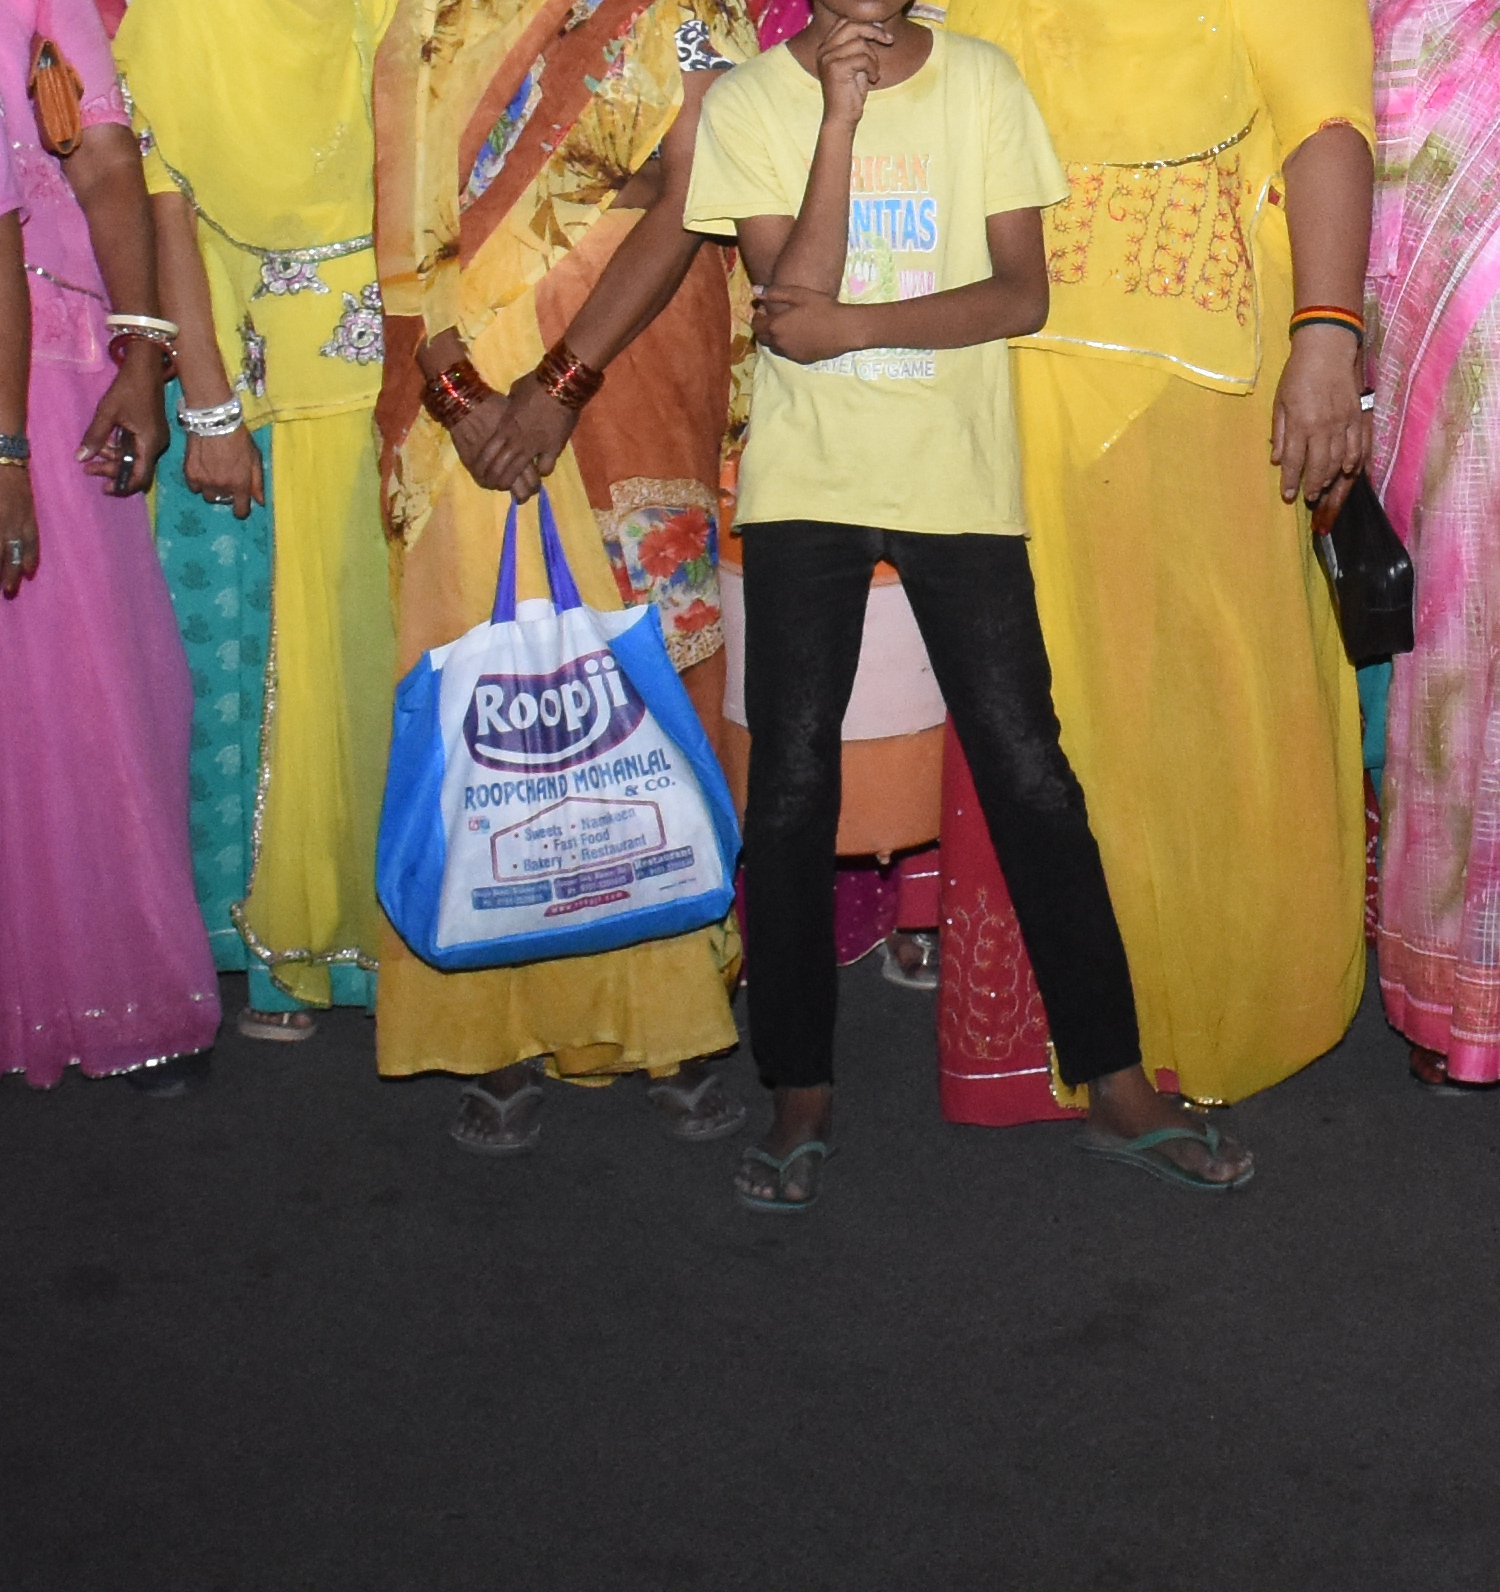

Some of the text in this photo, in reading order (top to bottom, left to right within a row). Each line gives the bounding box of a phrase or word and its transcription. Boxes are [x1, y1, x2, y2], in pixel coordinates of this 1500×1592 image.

[886, 360, 936, 379] GAME
[474, 655, 629, 764] Roopji
[464, 748, 672, 810] ROOPCHAND MOHANLAL
[624, 775, 676, 797] & CO.
[524, 824, 563, 842] Sweets
[553, 828, 611, 852] Fast Food
[581, 833, 647, 861] Restaurant
[523, 855, 563, 872] Bakery
